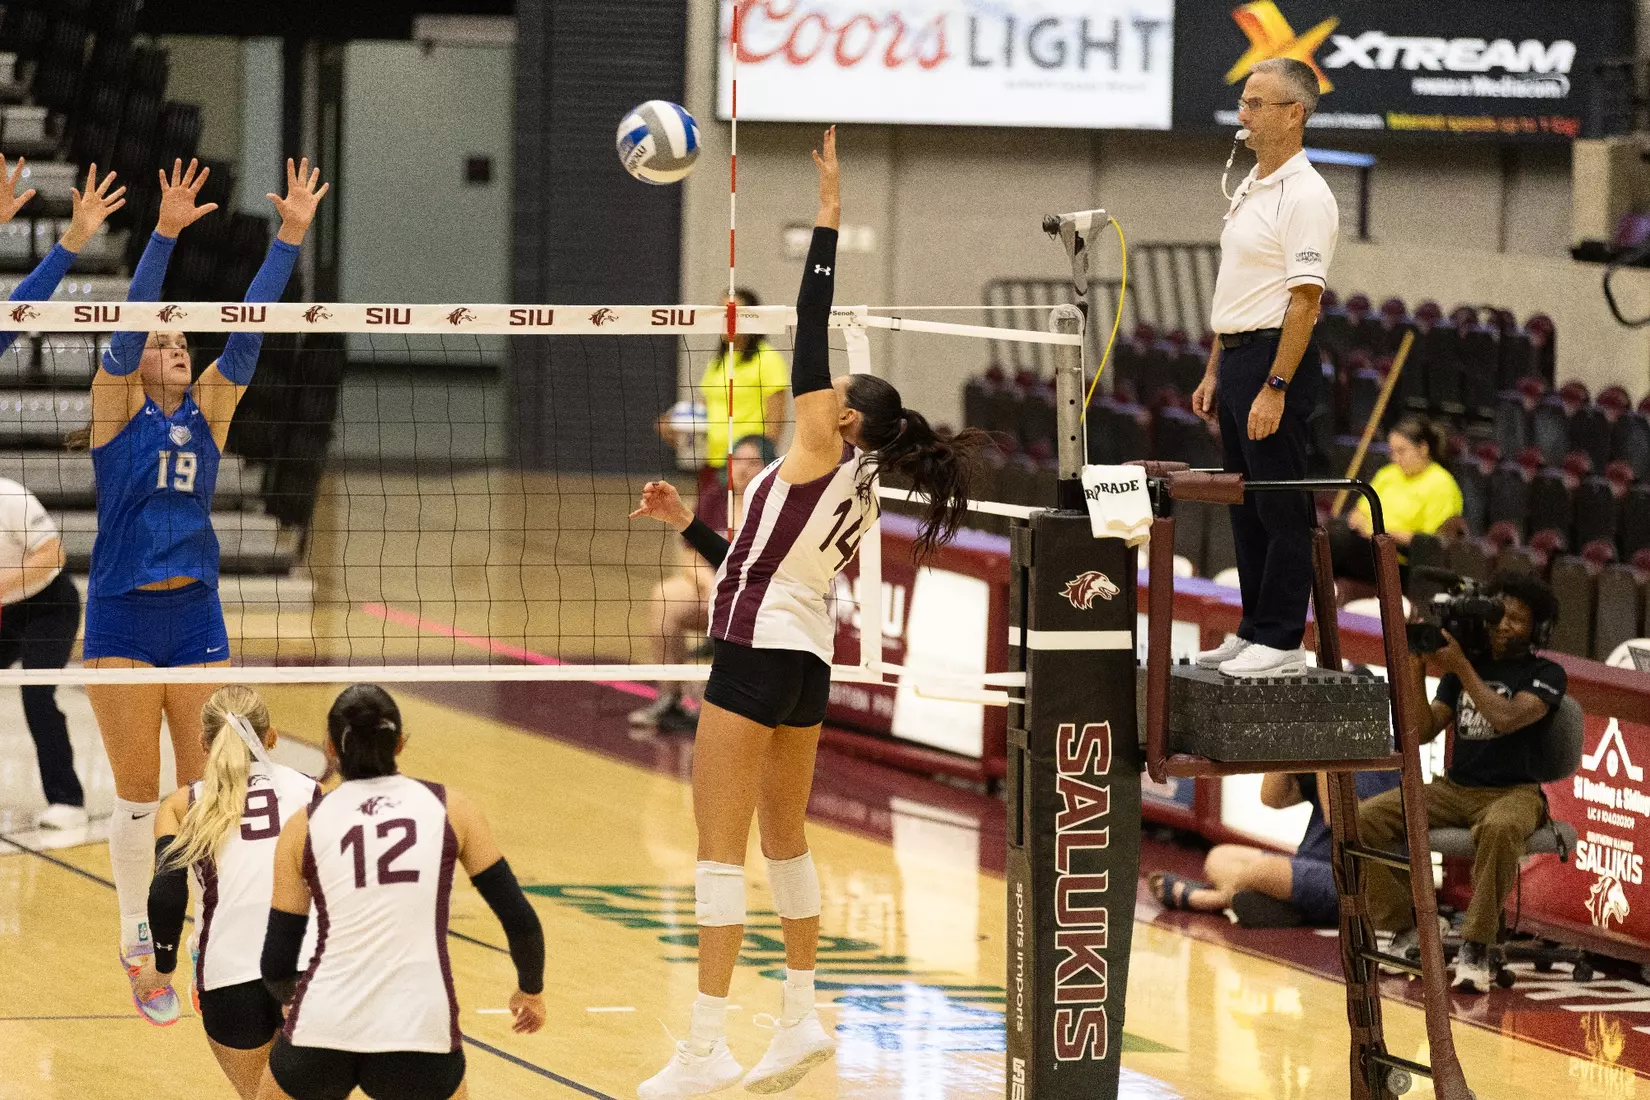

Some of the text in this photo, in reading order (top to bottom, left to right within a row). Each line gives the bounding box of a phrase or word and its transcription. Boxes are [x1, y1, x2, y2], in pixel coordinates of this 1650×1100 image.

[730, 0, 1170, 72] Coors LIGHT
[1324, 30, 1577, 73] XTREAM
[74, 305, 695, 326] SIU SIU SIU SIU SIU
[157, 450, 197, 493] 19
[818, 497, 864, 572] 14
[240, 788, 281, 841] 9
[340, 817, 420, 889] 12
[1575, 839, 1644, 885] SALUKIS
[1053, 720, 1112, 1062] SALUKIS
[1015, 882, 1026, 1033] sports imports
